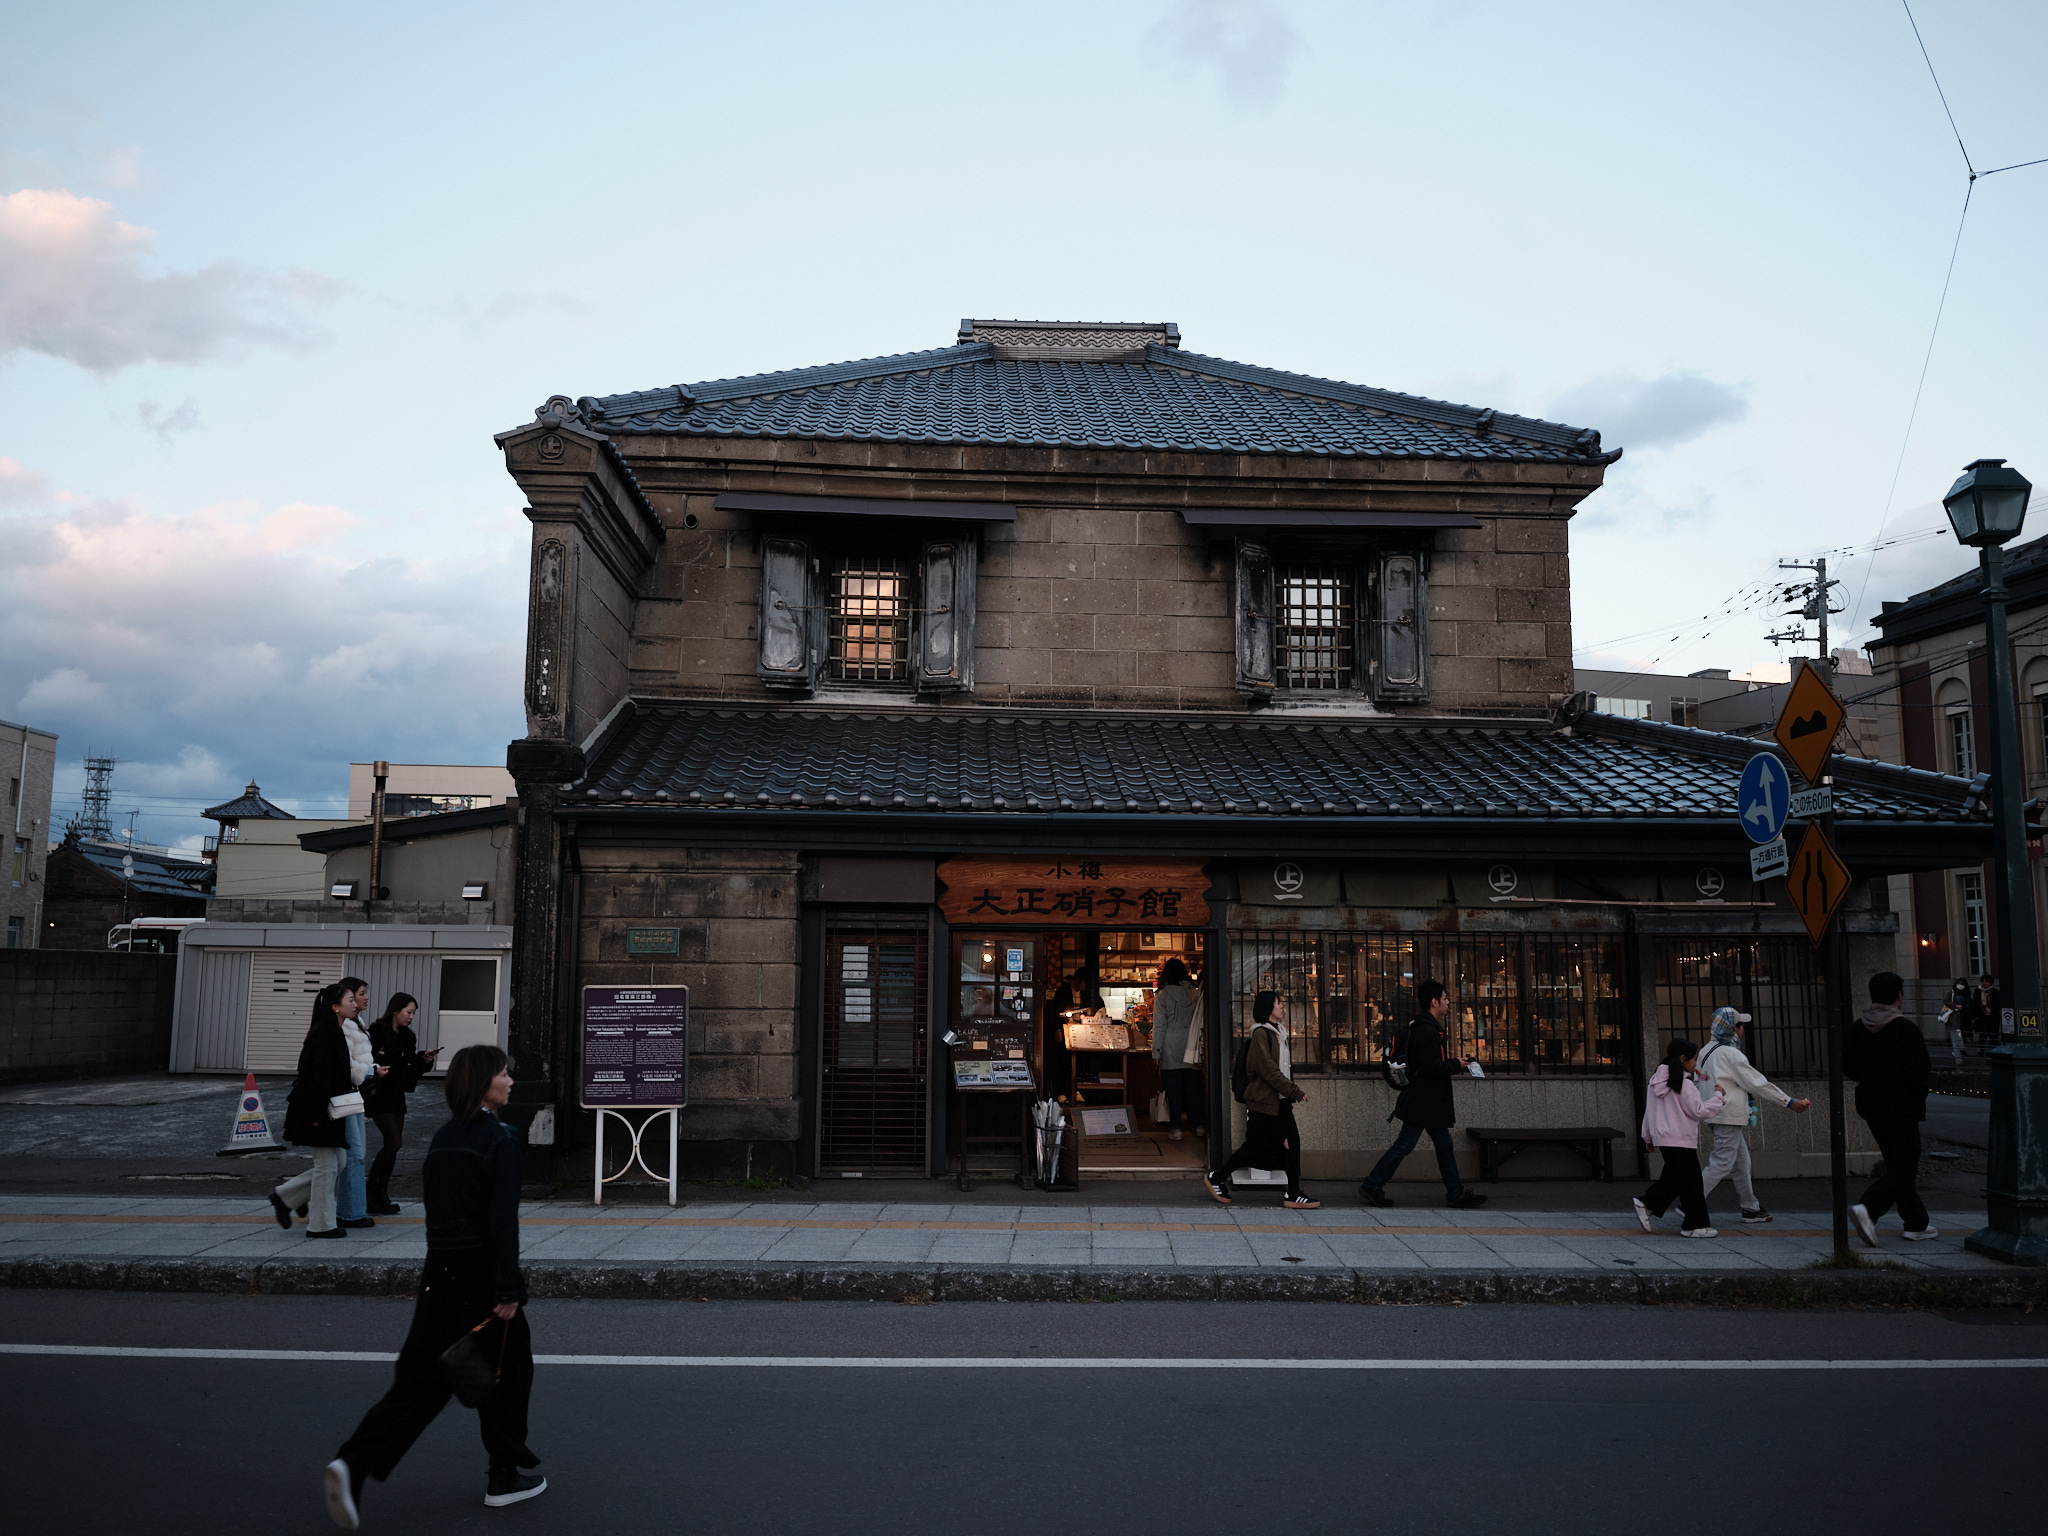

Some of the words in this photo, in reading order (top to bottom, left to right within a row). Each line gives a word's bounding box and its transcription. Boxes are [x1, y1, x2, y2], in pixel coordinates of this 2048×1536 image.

[1793, 792, 1831, 813] この先60m
[1752, 844, 1785, 863] 一方通行路
[1046, 861, 1104, 880] 小樽
[967, 887, 1182, 919] 大正硝子館
[2021, 1015, 2038, 1028] 04
[238, 1122, 264, 1133] 駐車禁止
